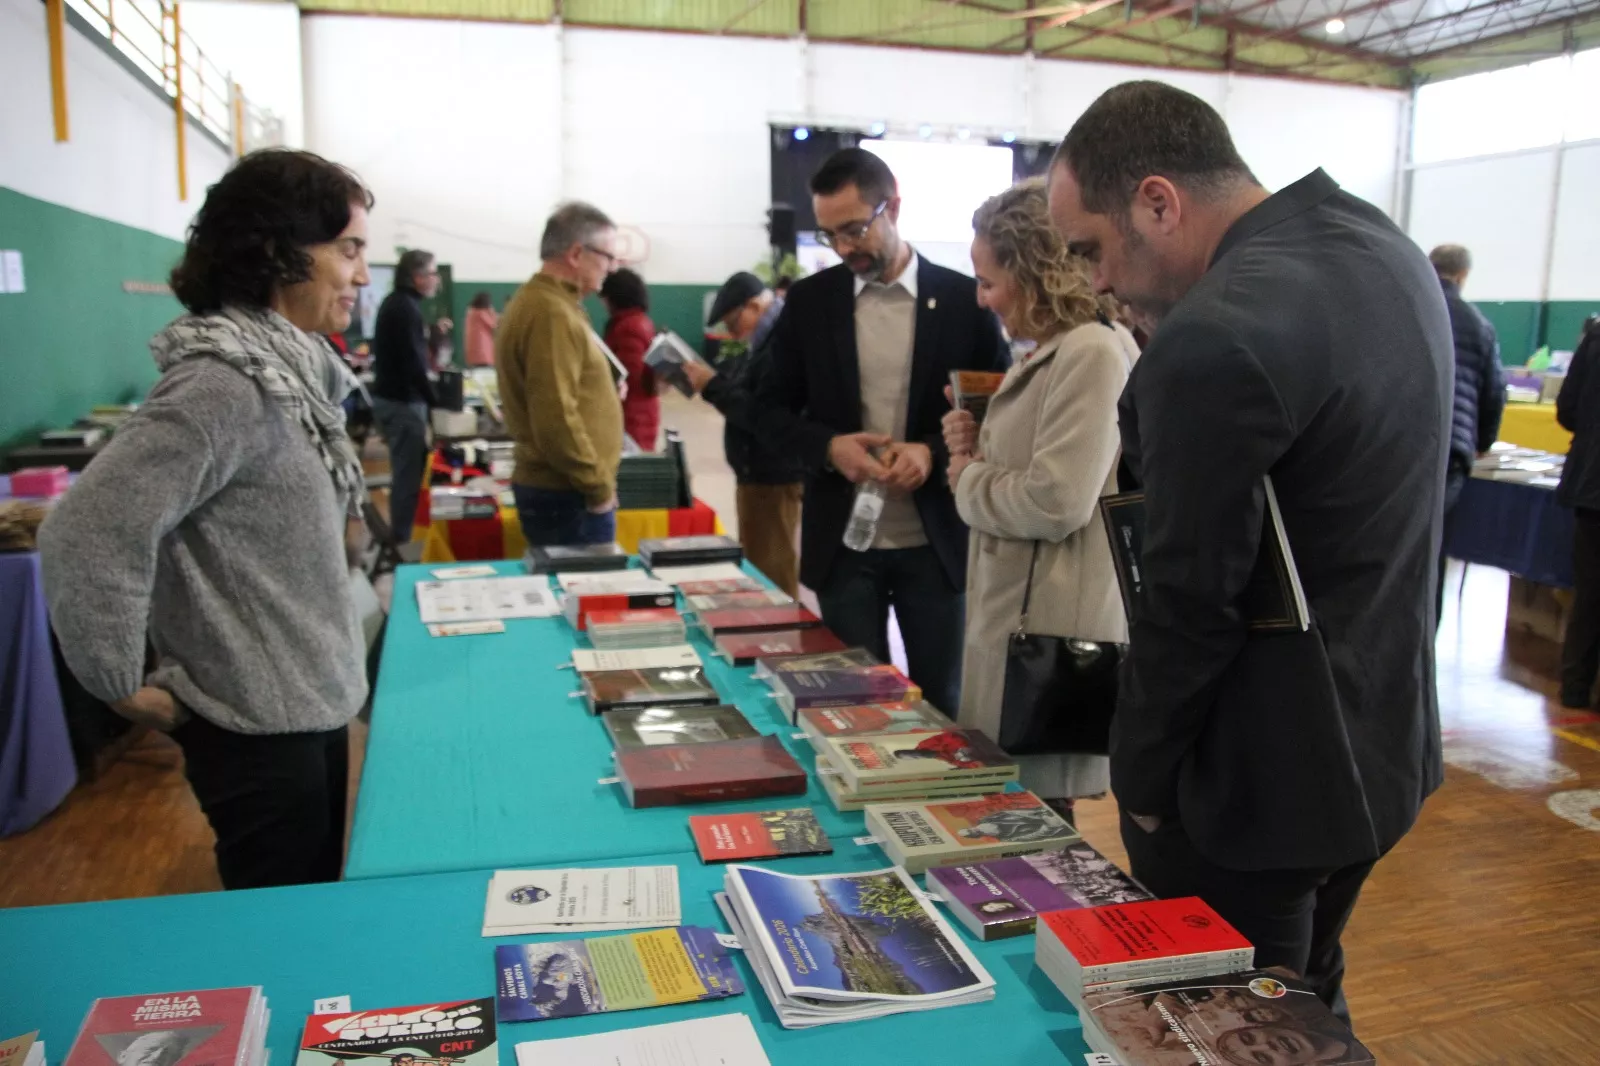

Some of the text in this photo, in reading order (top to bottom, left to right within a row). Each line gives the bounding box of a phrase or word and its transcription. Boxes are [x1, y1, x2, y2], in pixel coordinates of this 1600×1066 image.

[783, 937, 809, 974] Calendario
[503, 967, 517, 998] SALVEMOS
[513, 963, 529, 999] CANAL ROYA
[136, 1003, 201, 1014] MISMA
[144, 995, 198, 1006] EN LA
[131, 1010, 202, 1021] TIERRA
[1155, 1001, 1191, 1043] sindicalismo
[339, 1016, 482, 1040] PUEBLO
[318, 1039, 376, 1048] CENTENARIO
[440, 1040, 476, 1053] CNT
[1187, 1043, 1210, 1066] Nuevo
